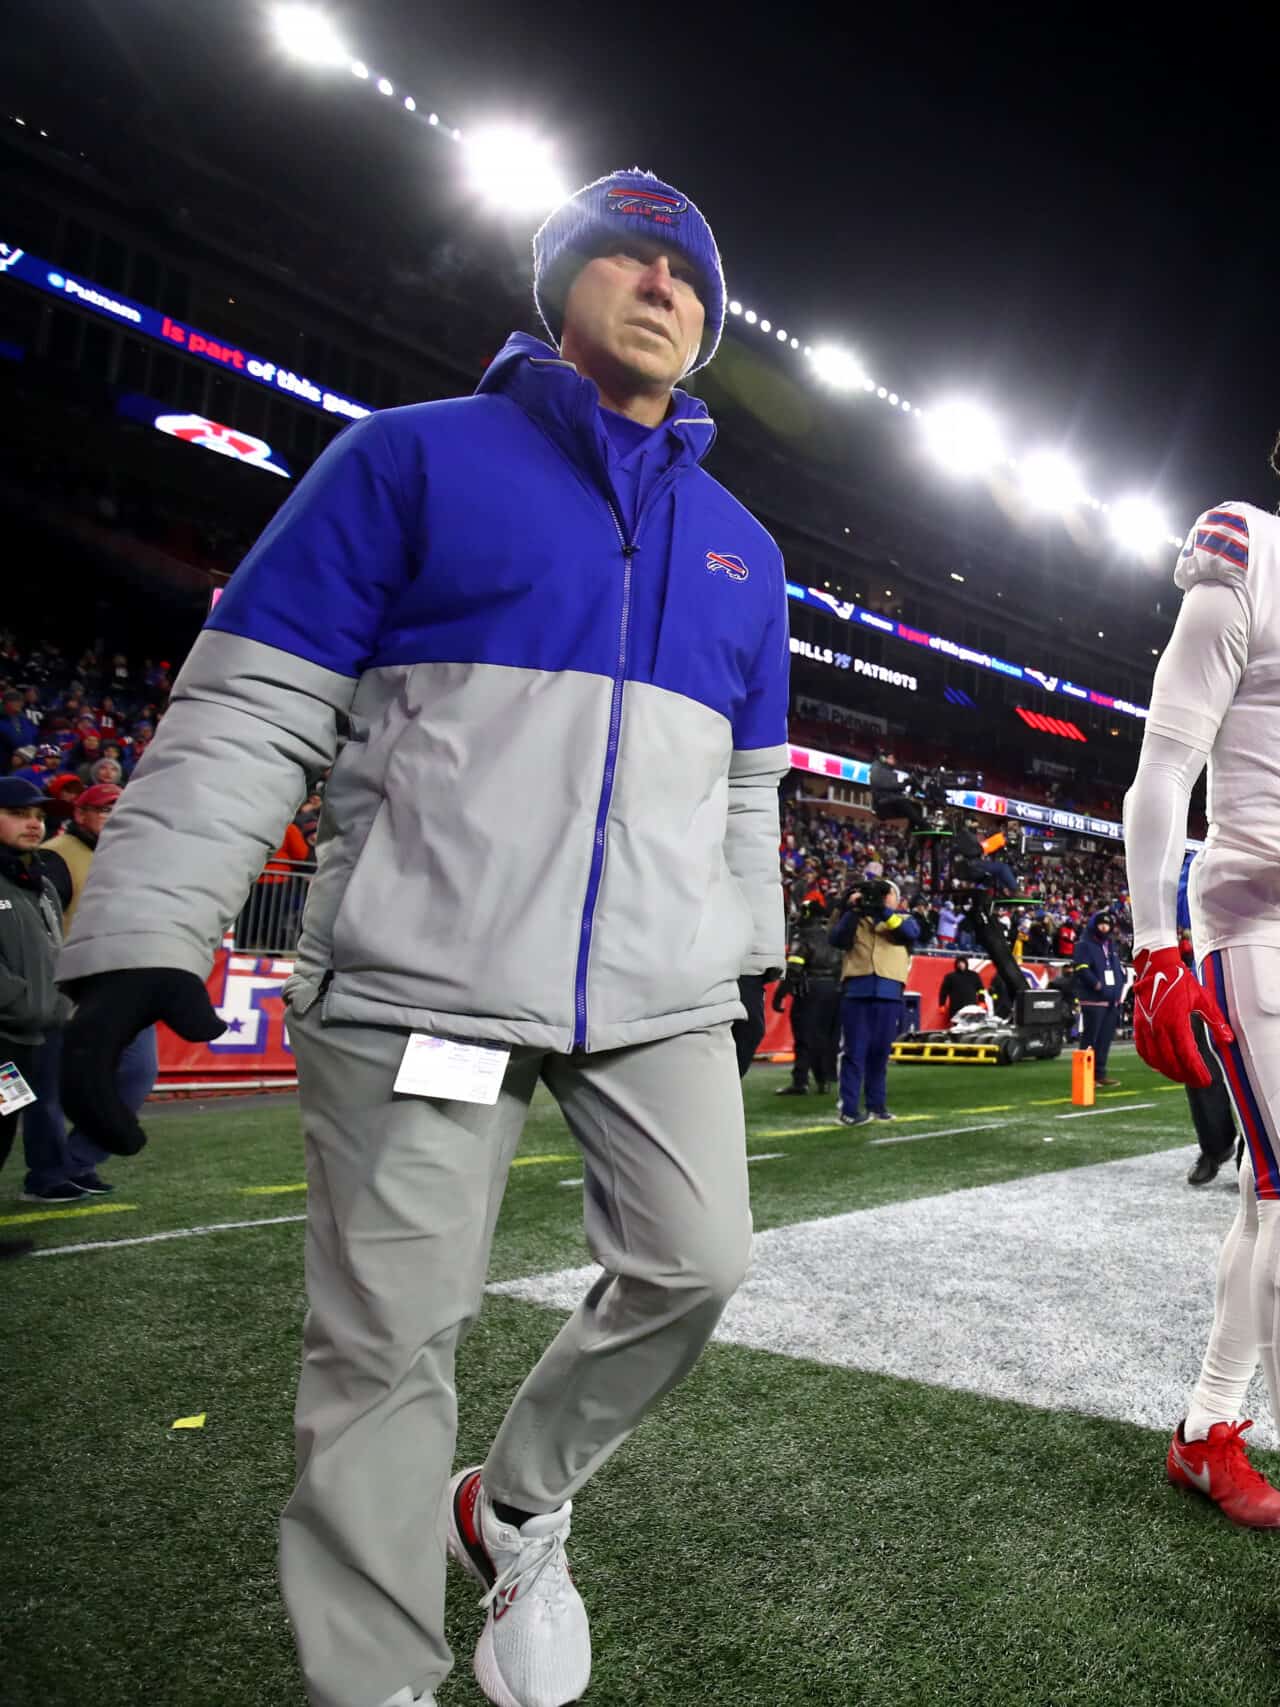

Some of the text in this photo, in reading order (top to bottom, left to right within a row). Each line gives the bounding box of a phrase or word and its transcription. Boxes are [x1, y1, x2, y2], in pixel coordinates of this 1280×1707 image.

[188, 333, 244, 369] part
[247, 360, 276, 381] of
[277, 369, 321, 402] this
[789, 637, 834, 664] BILLS
[854, 659, 917, 690] PATRIOTS
